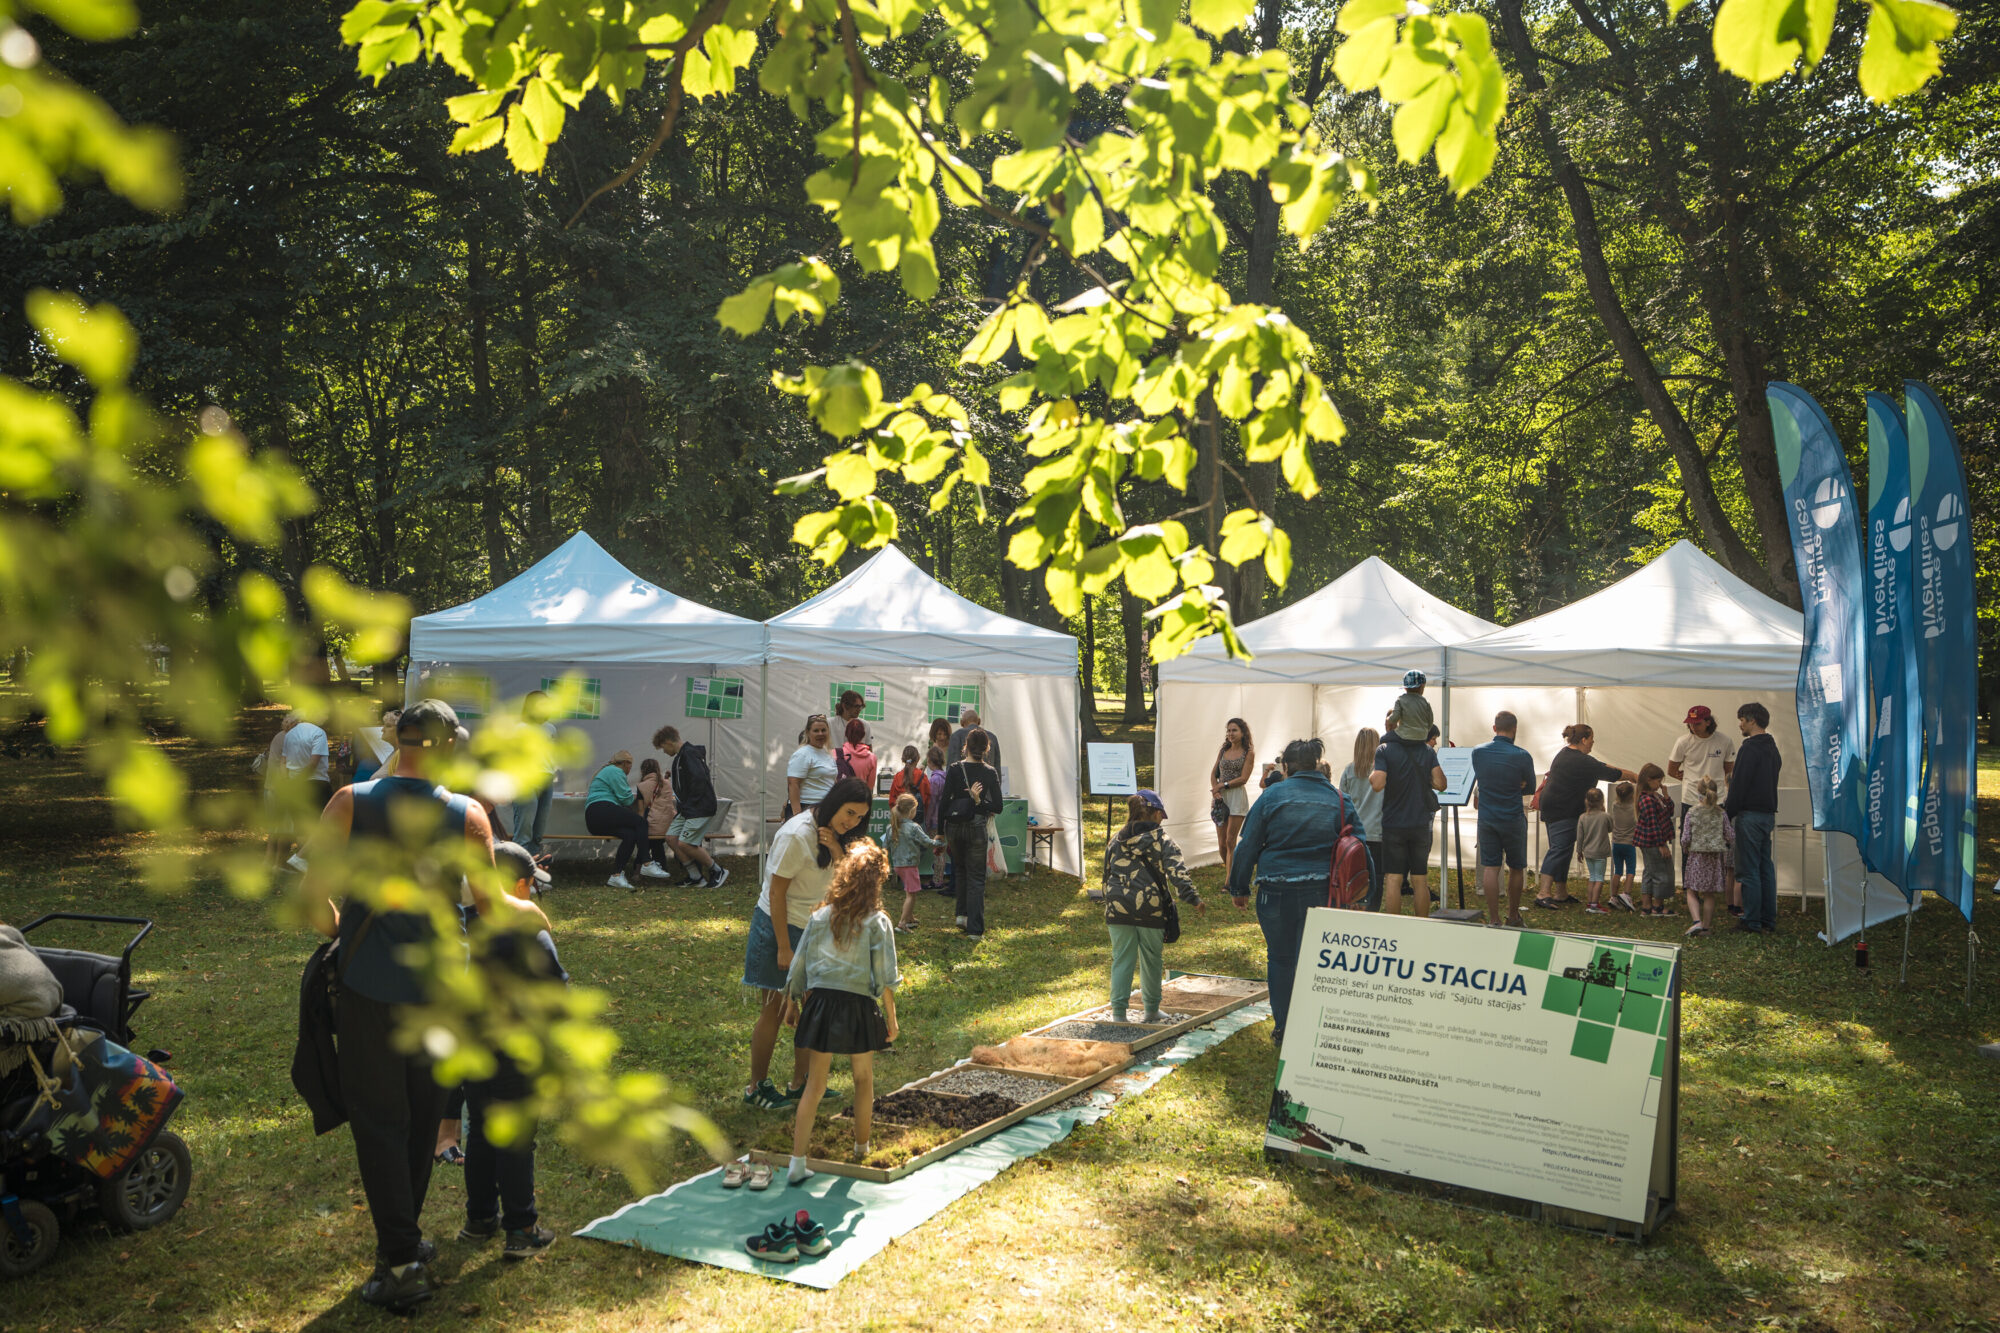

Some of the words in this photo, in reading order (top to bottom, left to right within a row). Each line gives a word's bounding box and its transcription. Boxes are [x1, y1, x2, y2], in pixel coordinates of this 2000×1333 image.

[870, 808, 891, 820] JŪR
[1321, 931, 1398, 952] KAROSTAS
[1317, 949, 1414, 979] SAJŪTU
[1422, 963, 1527, 995] STACIJA
[1311, 984, 1337, 994] četros
[1339, 988, 1374, 1001] pieturas
[1376, 993, 1414, 1006] punktos.
[1313, 974, 1348, 986] Iepazīsti
[1352, 980, 1368, 988] sevi
[1387, 985, 1424, 996] Karostas
[1429, 990, 1445, 999] vidi
[1487, 998, 1525, 1013] stacijas"
[1323, 1022, 1344, 1030] DABAS
[1346, 1024, 1390, 1037] PIESKĀRIENS
[1320, 1040, 1341, 1050] JŪRAS
[1342, 1045, 1363, 1055] GURĶI
[1315, 1062, 1345, 1072] KAROSTA
[1351, 1067, 1387, 1079] NĀKOTNES
[1388, 1073, 1439, 1088] DAŽĀDPILSĒTA
